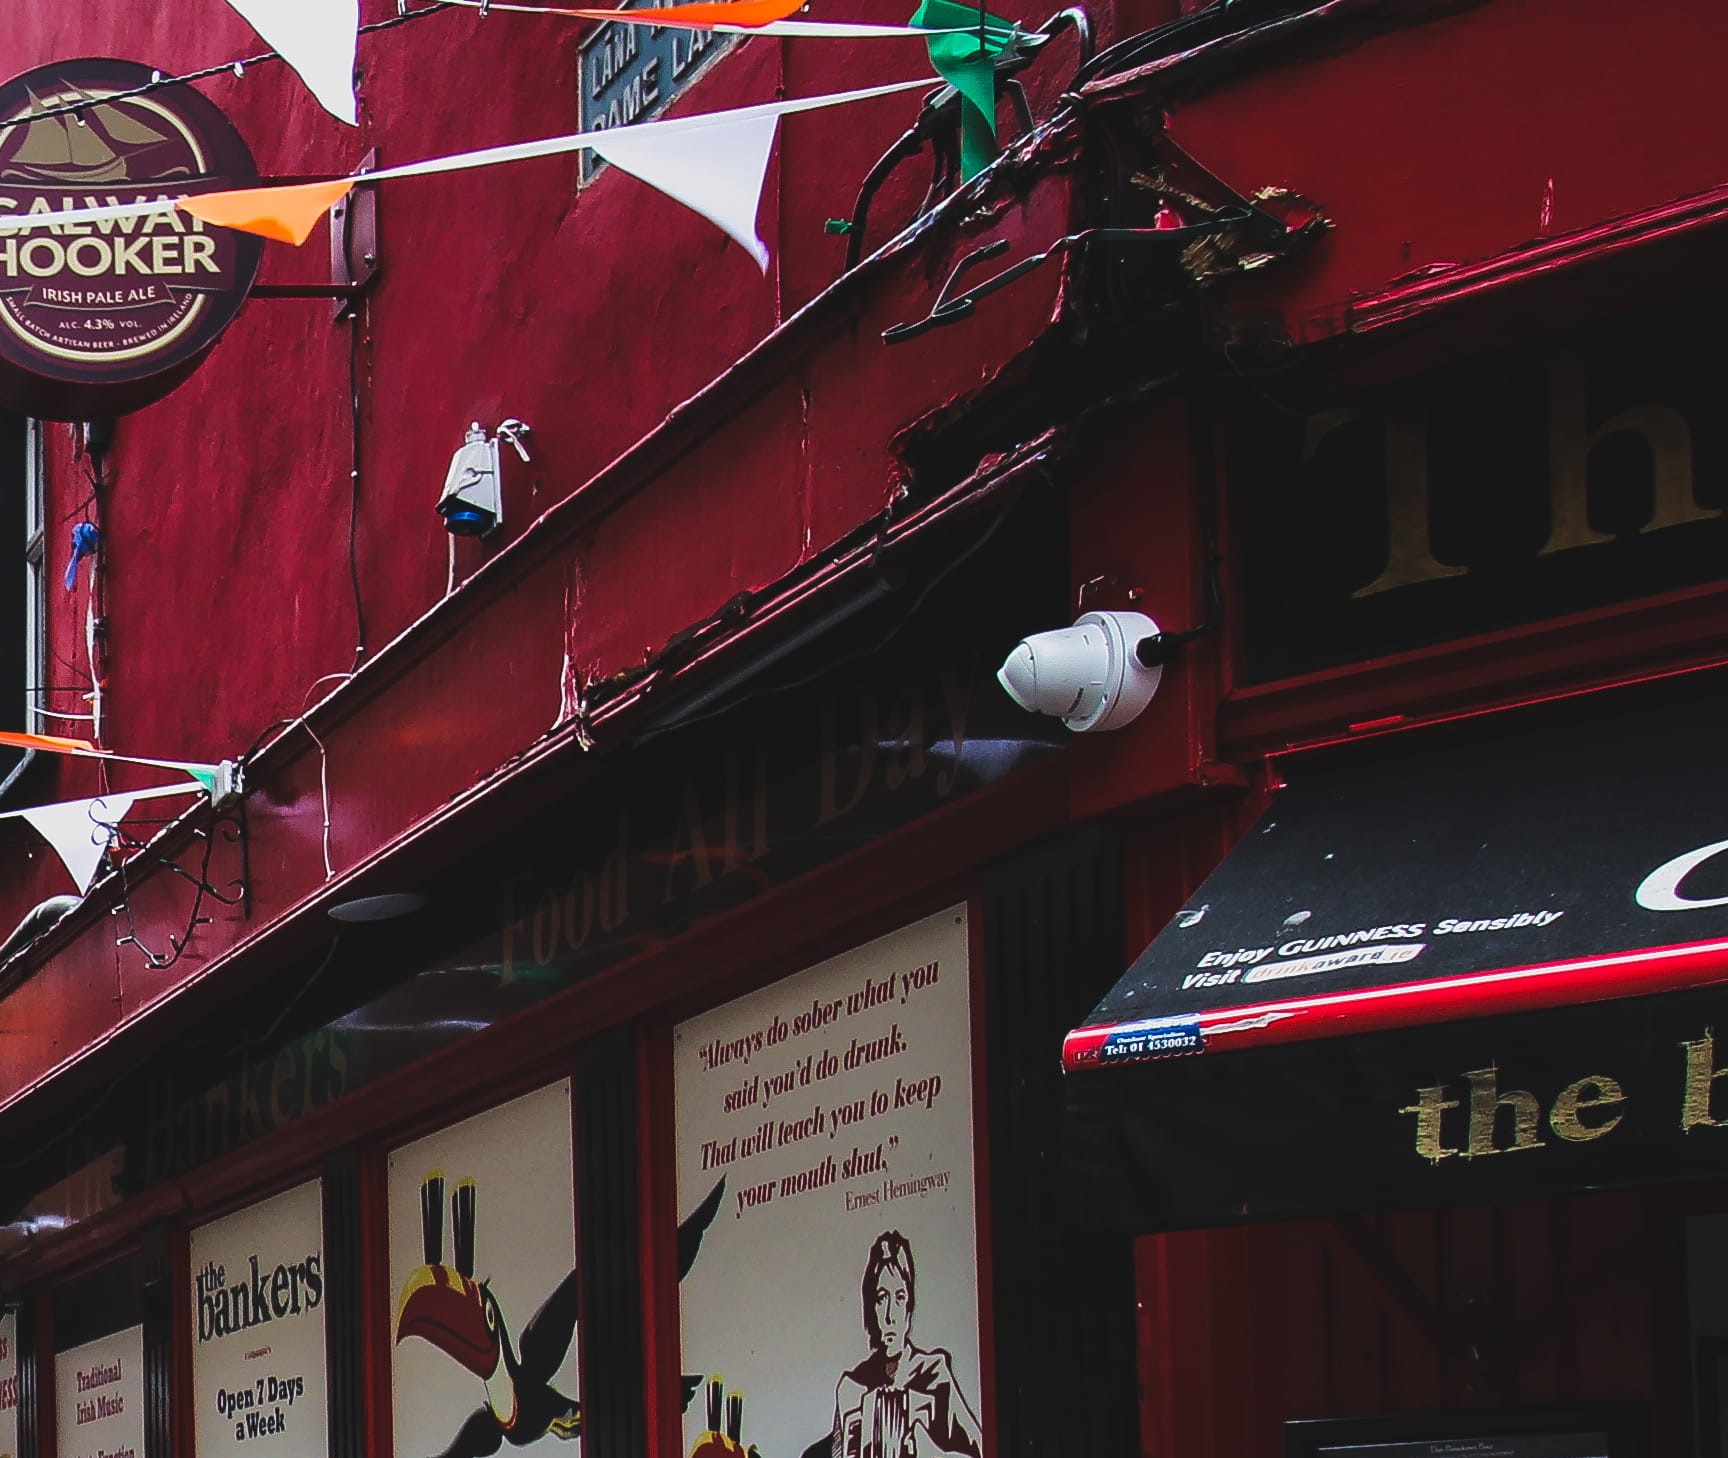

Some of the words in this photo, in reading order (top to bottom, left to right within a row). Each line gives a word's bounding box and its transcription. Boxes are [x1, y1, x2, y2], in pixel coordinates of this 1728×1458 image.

[43, 288, 82, 303] IRISH
[86, 293, 124, 304] PALE
[128, 286, 156, 302] ALE
[1196, 946, 1275, 969] Enjoy
[1277, 923, 1427, 957] GUINNESS
[1431, 910, 1565, 937] Sensibly
[1180, 969, 1242, 991] Visit
[766, 1015, 790, 1048] do
[792, 997, 844, 1038] sober
[846, 971, 898, 1017] what
[899, 960, 940, 1005] you
[1129, 1042, 1144, 1053] 01
[1146, 1036, 1197, 1051] 4530032
[723, 1075, 760, 1114] said
[816, 1049, 840, 1082] do
[843, 1023, 908, 1072] drunk.
[700, 1135, 738, 1172] That
[741, 1120, 775, 1160] will
[777, 1105, 826, 1147] teach
[828, 1099, 866, 1140] you
[870, 1088, 890, 1117] to
[893, 1074, 943, 1111] keep
[1399, 1060, 1628, 1166] the
[735, 1180, 777, 1220] your
[779, 1154, 838, 1199] mouth
[845, 1187, 882, 1212] Ernest
[882, 1168, 952, 1205] Hemingway
[196, 1250, 324, 1345] bankers
[200, 1261, 226, 1292] the
[75, 1358, 122, 1394] Traditional
[217, 1387, 255, 1420] Open
[255, 1378, 266, 1406] 7
[267, 1375, 304, 1406] Days
[76, 1398, 97, 1425] Irish
[97, 1391, 124, 1421] Music
[235, 1422, 245, 1442] a
[245, 1406, 286, 1439] Week
